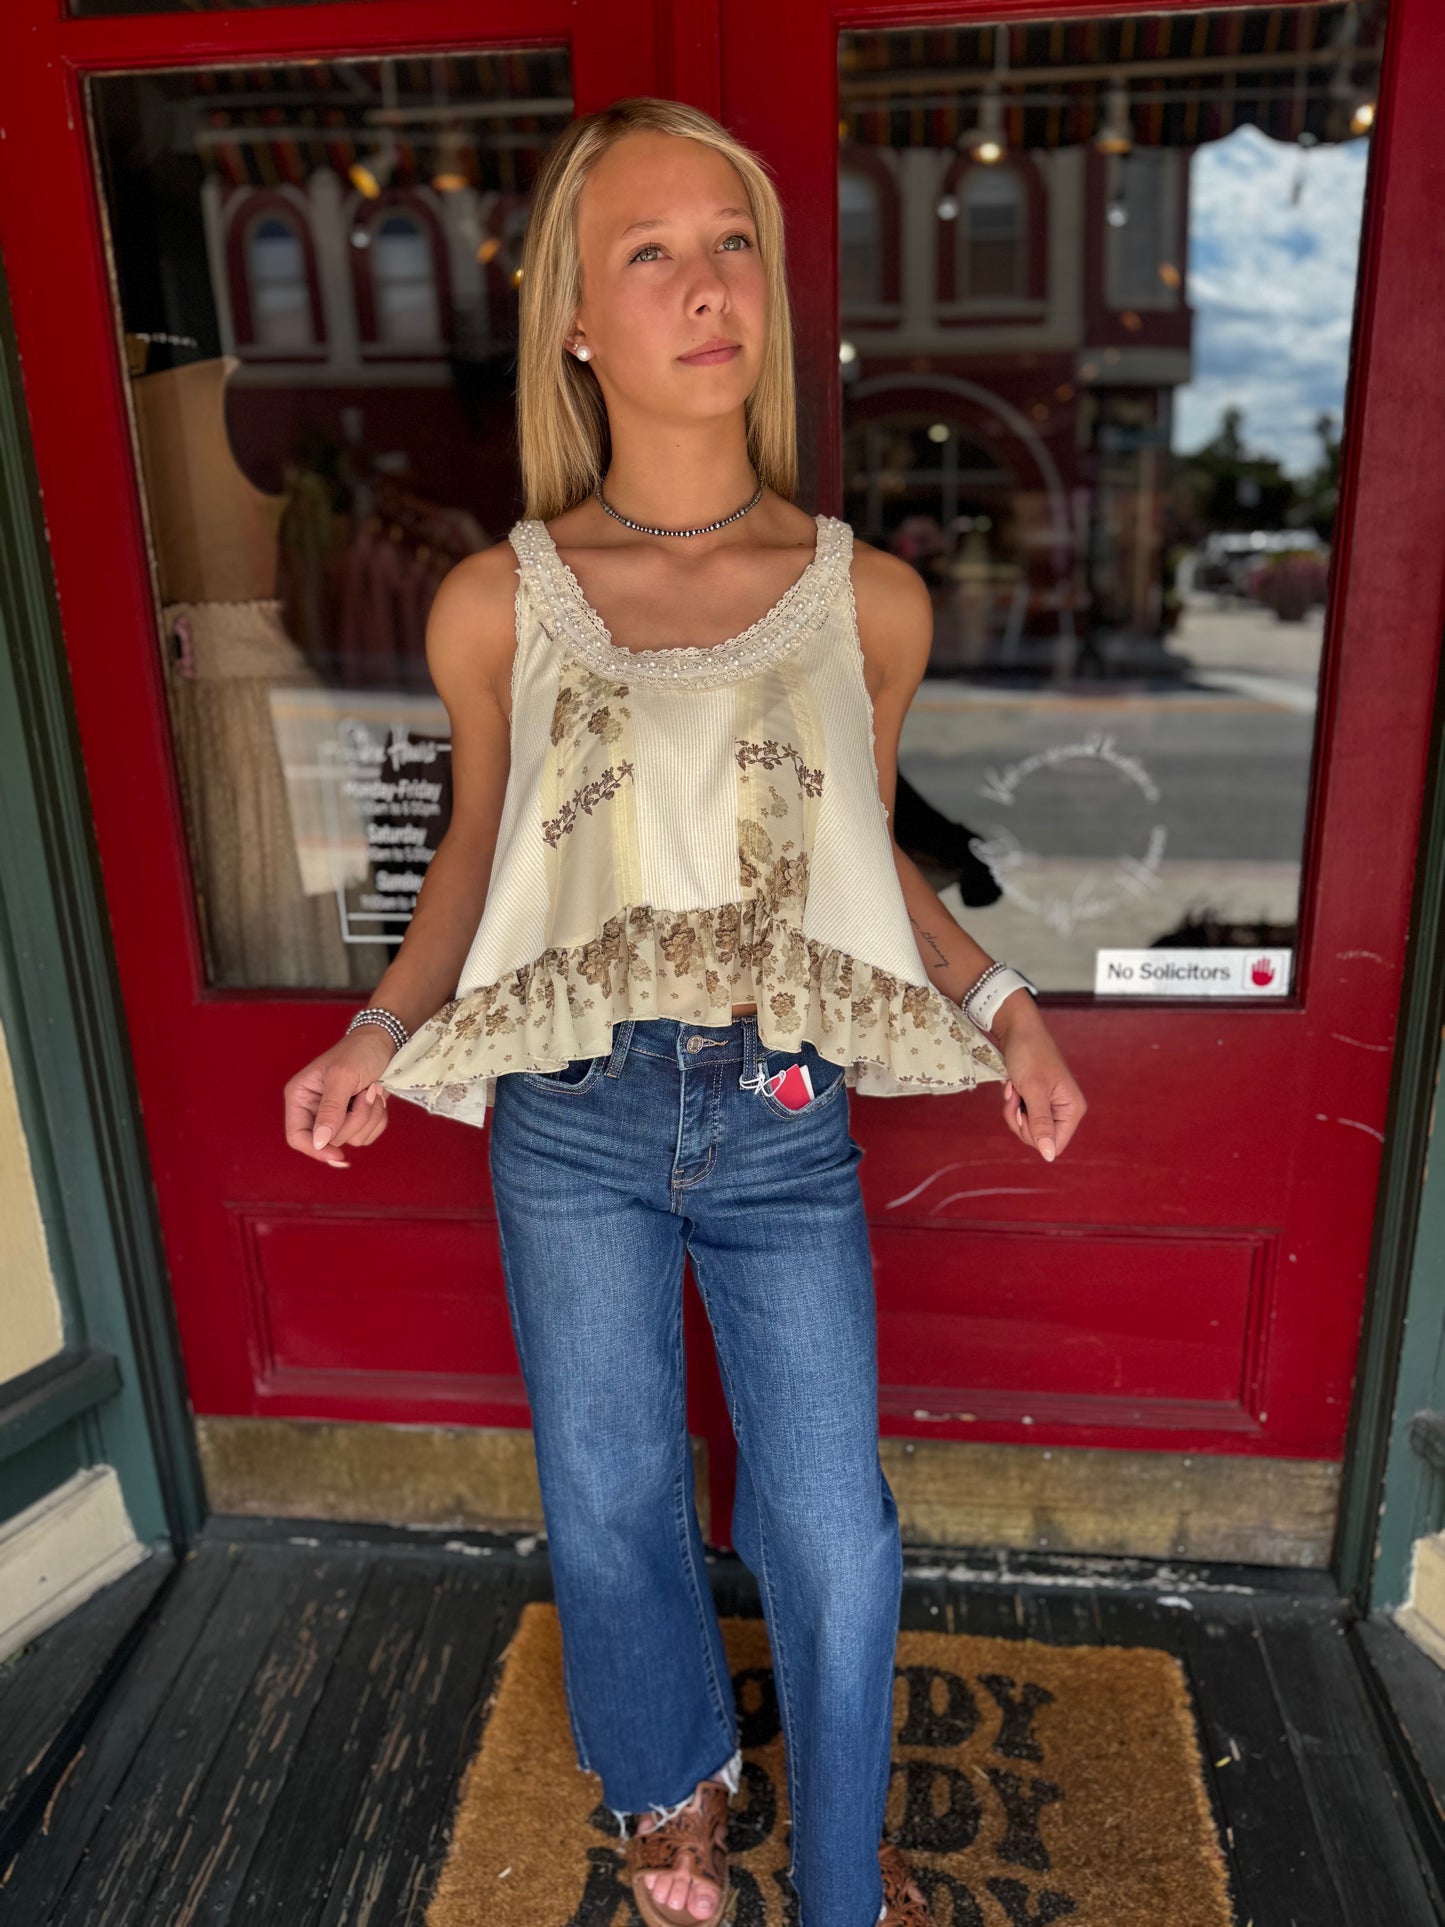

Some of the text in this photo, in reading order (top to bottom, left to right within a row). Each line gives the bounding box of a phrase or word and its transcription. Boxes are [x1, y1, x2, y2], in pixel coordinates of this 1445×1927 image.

[367, 823, 427, 847] Saturday
[1107, 962, 1231, 981] No Solicitors
